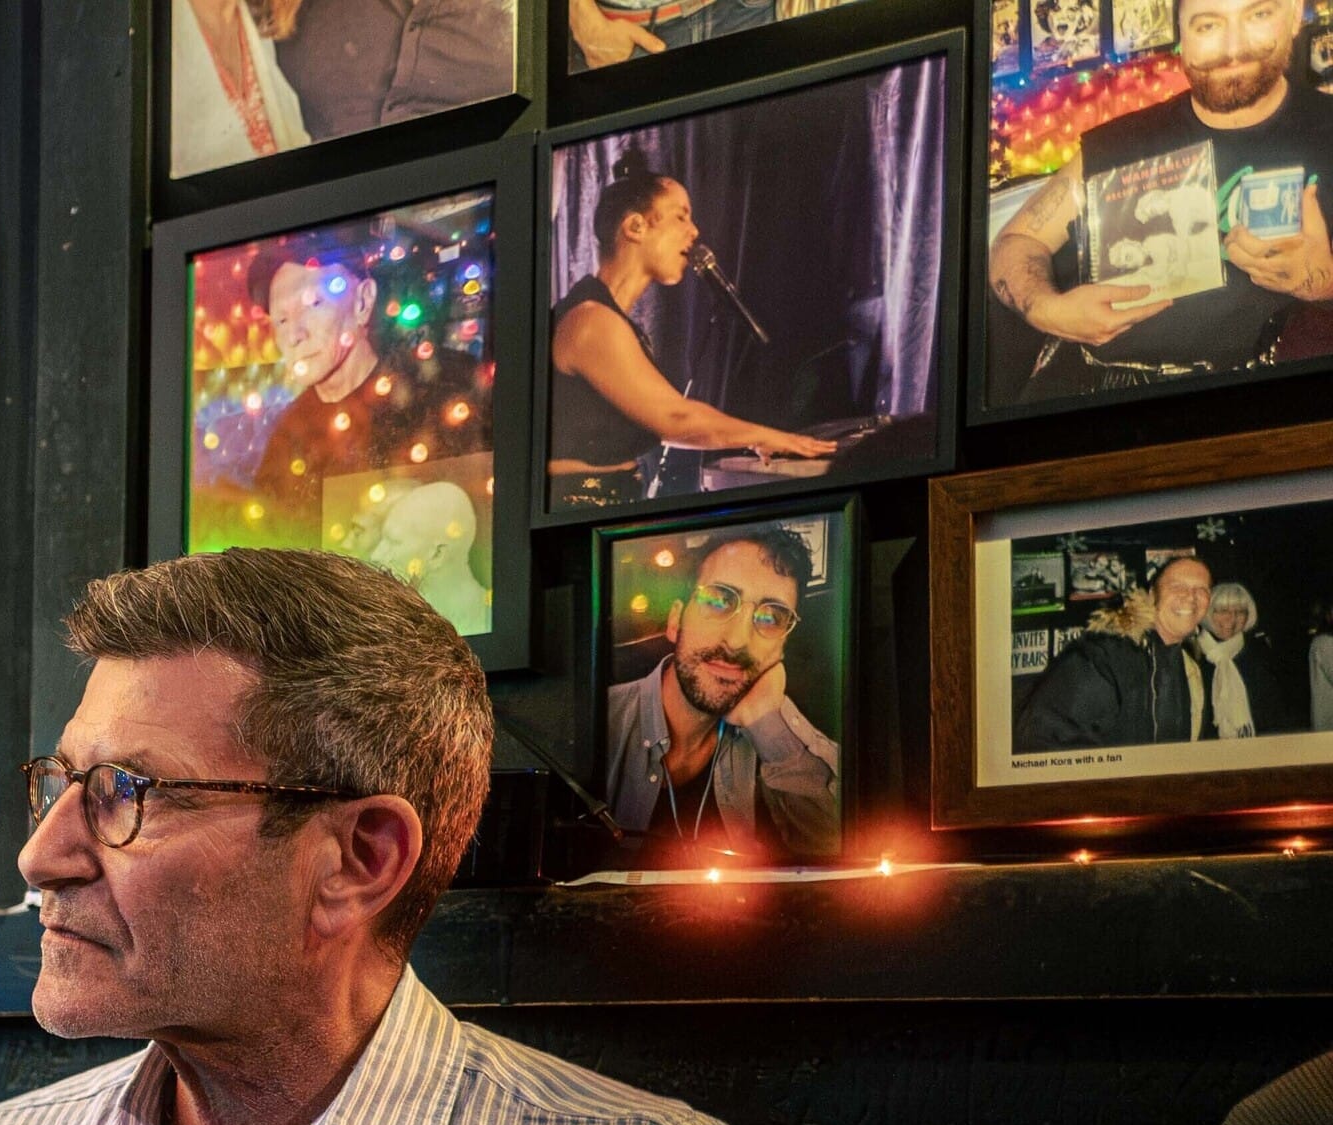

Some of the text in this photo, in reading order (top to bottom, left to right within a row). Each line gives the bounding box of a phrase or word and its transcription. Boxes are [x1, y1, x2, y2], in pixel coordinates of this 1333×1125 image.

[1012, 753, 1123, 769] Michael Kors with a fan
